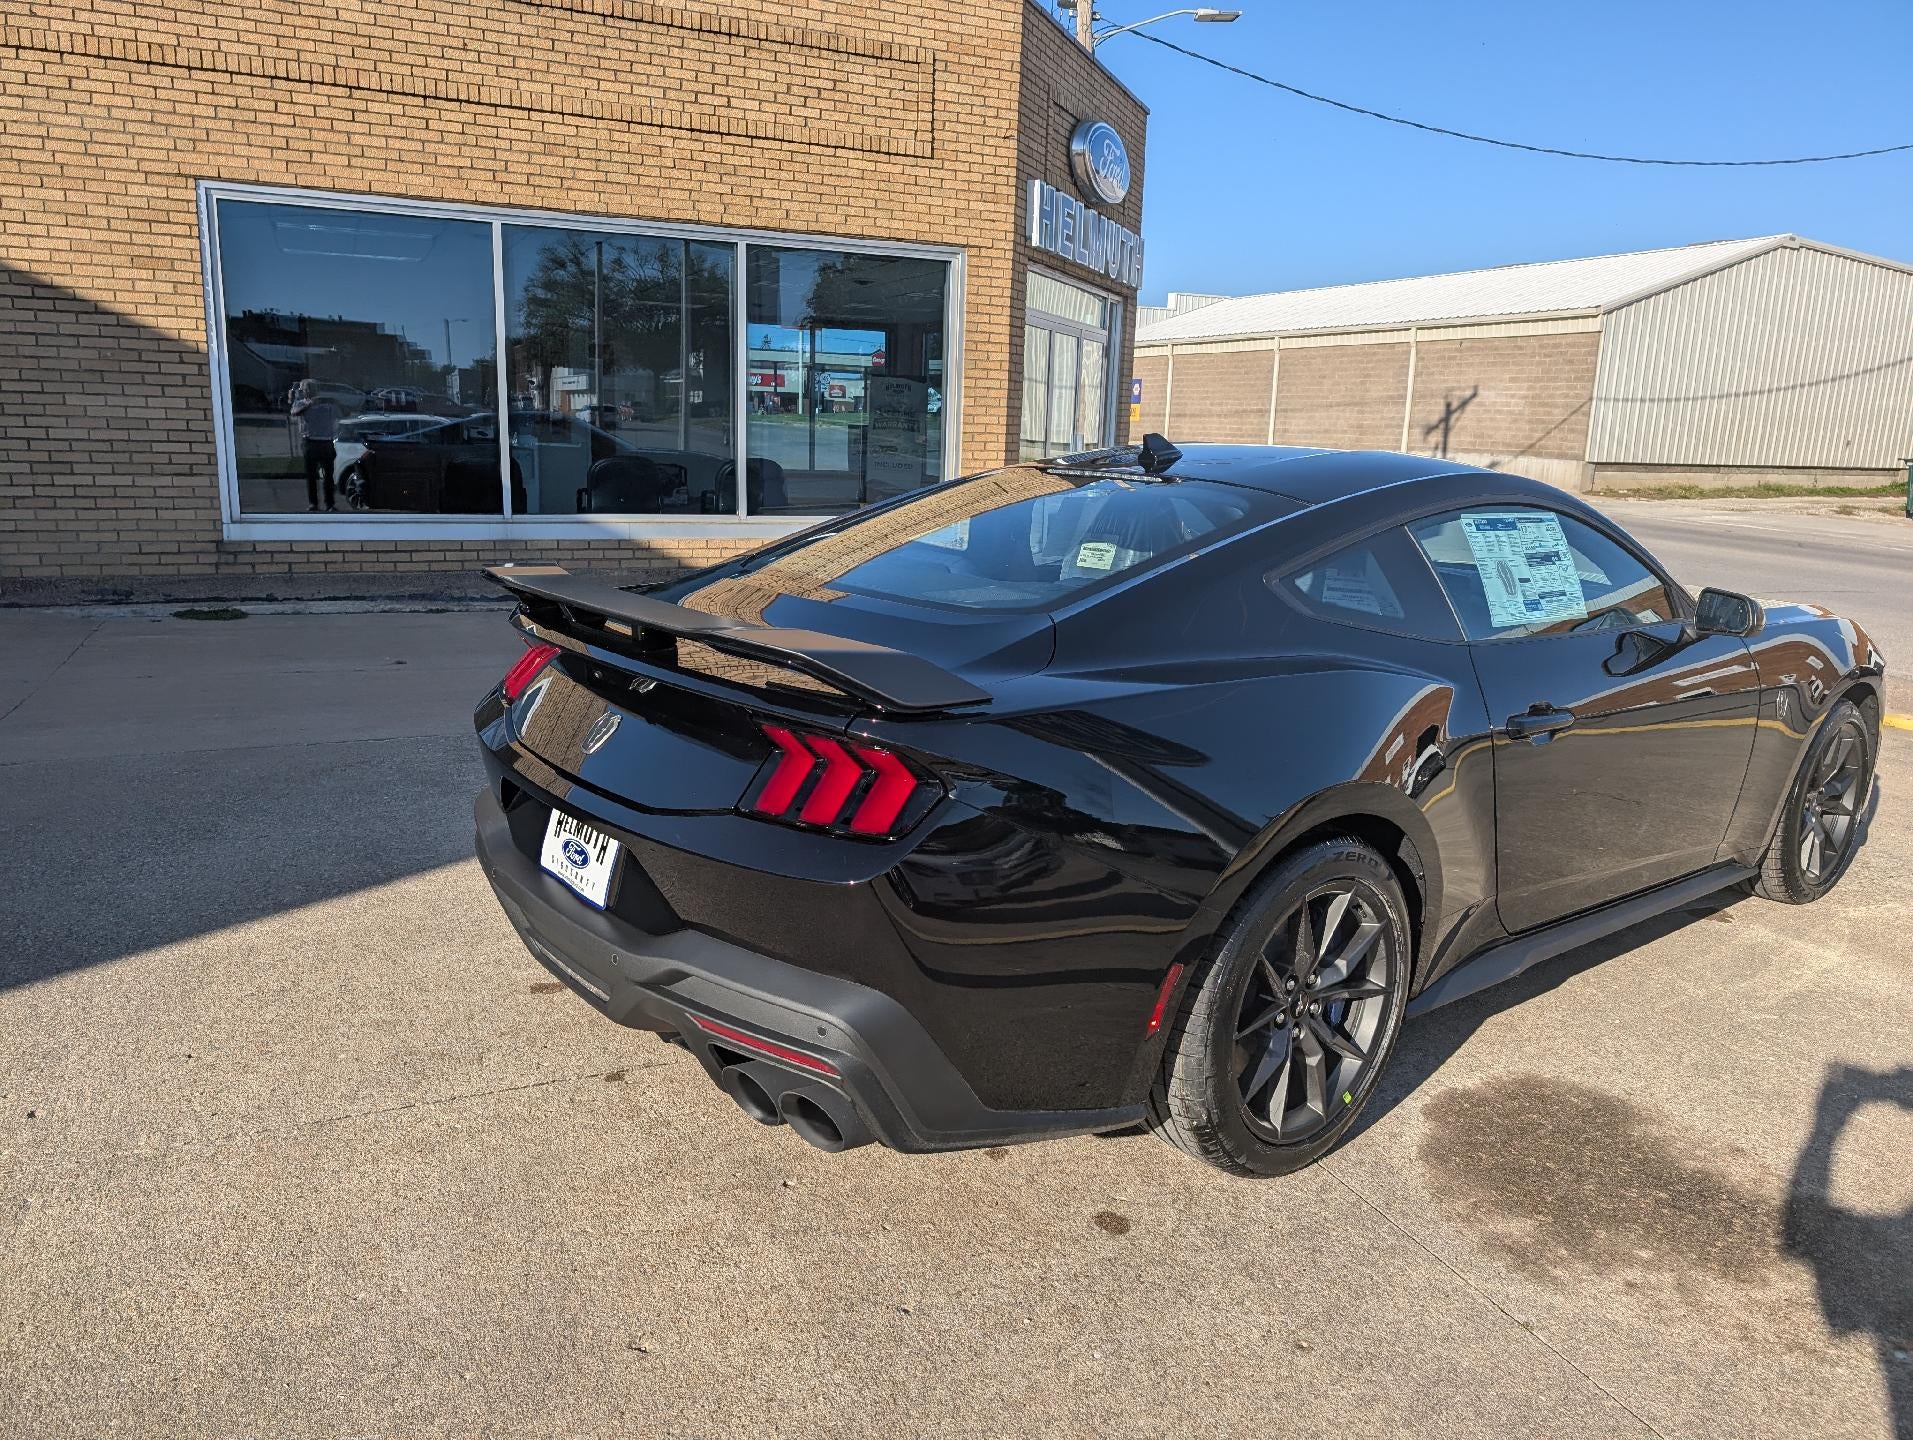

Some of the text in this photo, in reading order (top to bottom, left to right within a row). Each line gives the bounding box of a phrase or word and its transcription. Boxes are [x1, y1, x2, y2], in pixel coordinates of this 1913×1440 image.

[1100, 139, 1127, 189] Ford
[1032, 179, 1144, 290] HELMUTH
[554, 811, 610, 866] HELMUTH
[566, 841, 585, 865] Ford
[1333, 851, 1379, 866] ZERO
